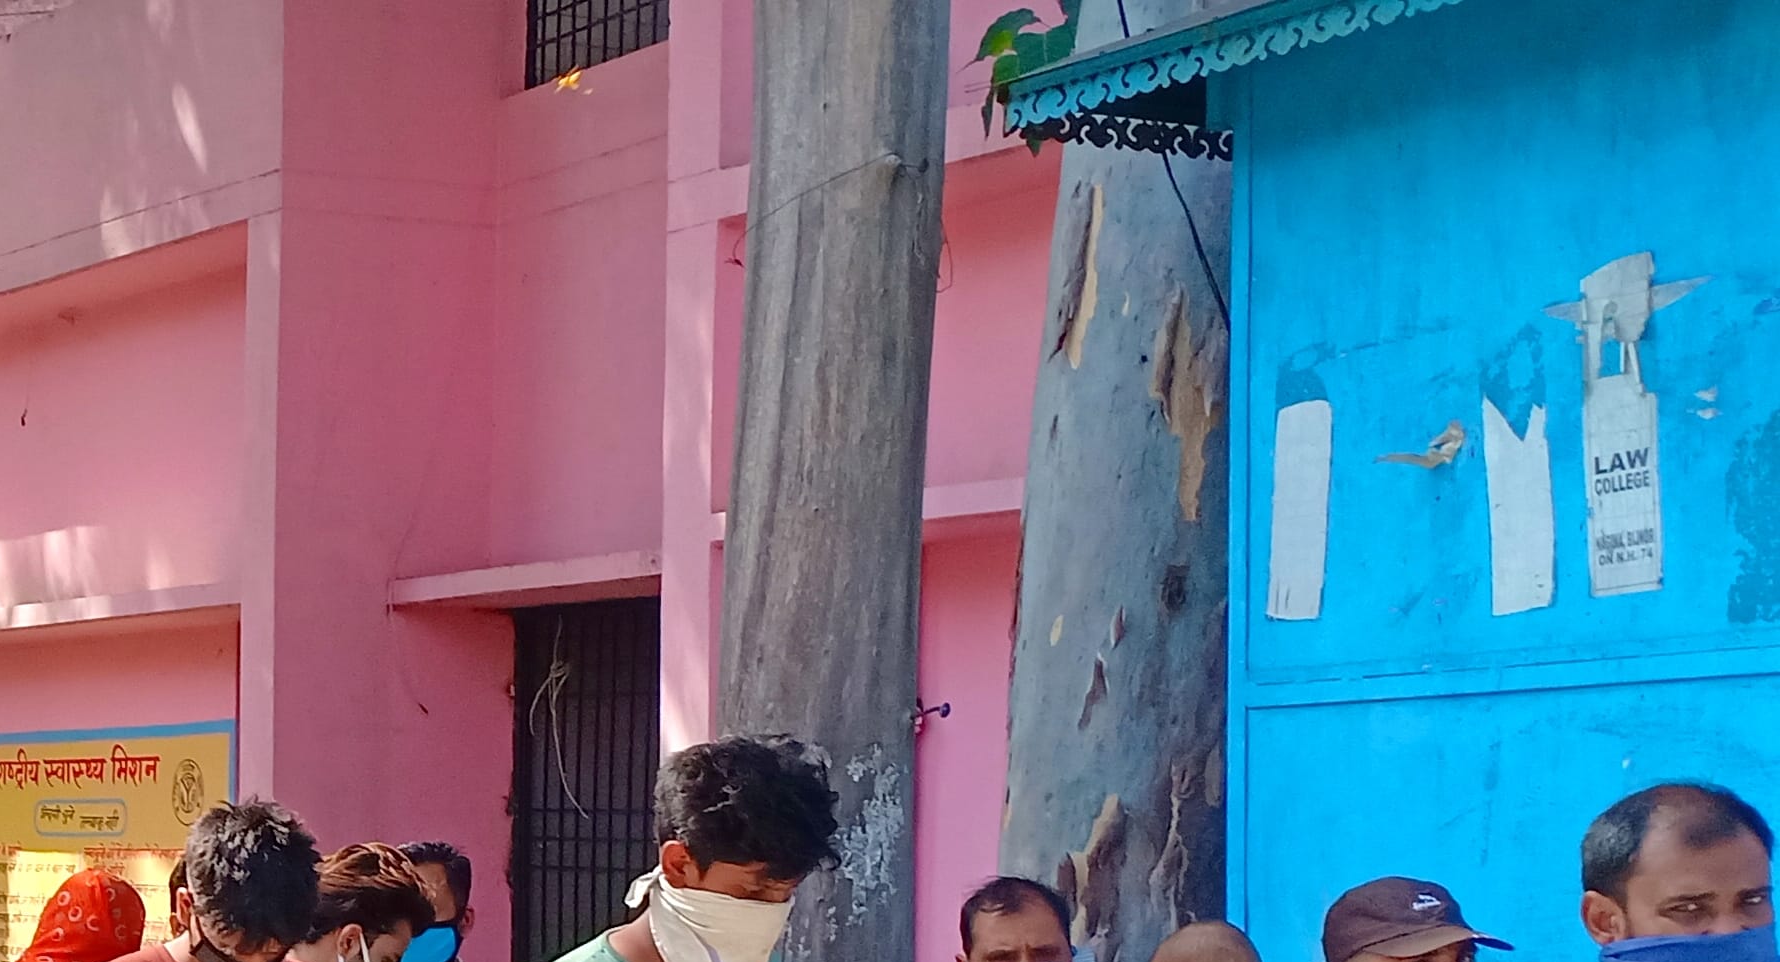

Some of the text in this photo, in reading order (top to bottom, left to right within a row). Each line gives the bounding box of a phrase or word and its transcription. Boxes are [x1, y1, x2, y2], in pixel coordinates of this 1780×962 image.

[1594, 447, 1649, 475] LAW
[1595, 471, 1650, 496] COLLEGE
[43, 758, 107, 789] स्वास्थ्य
[111, 744, 160, 787] मिशन
